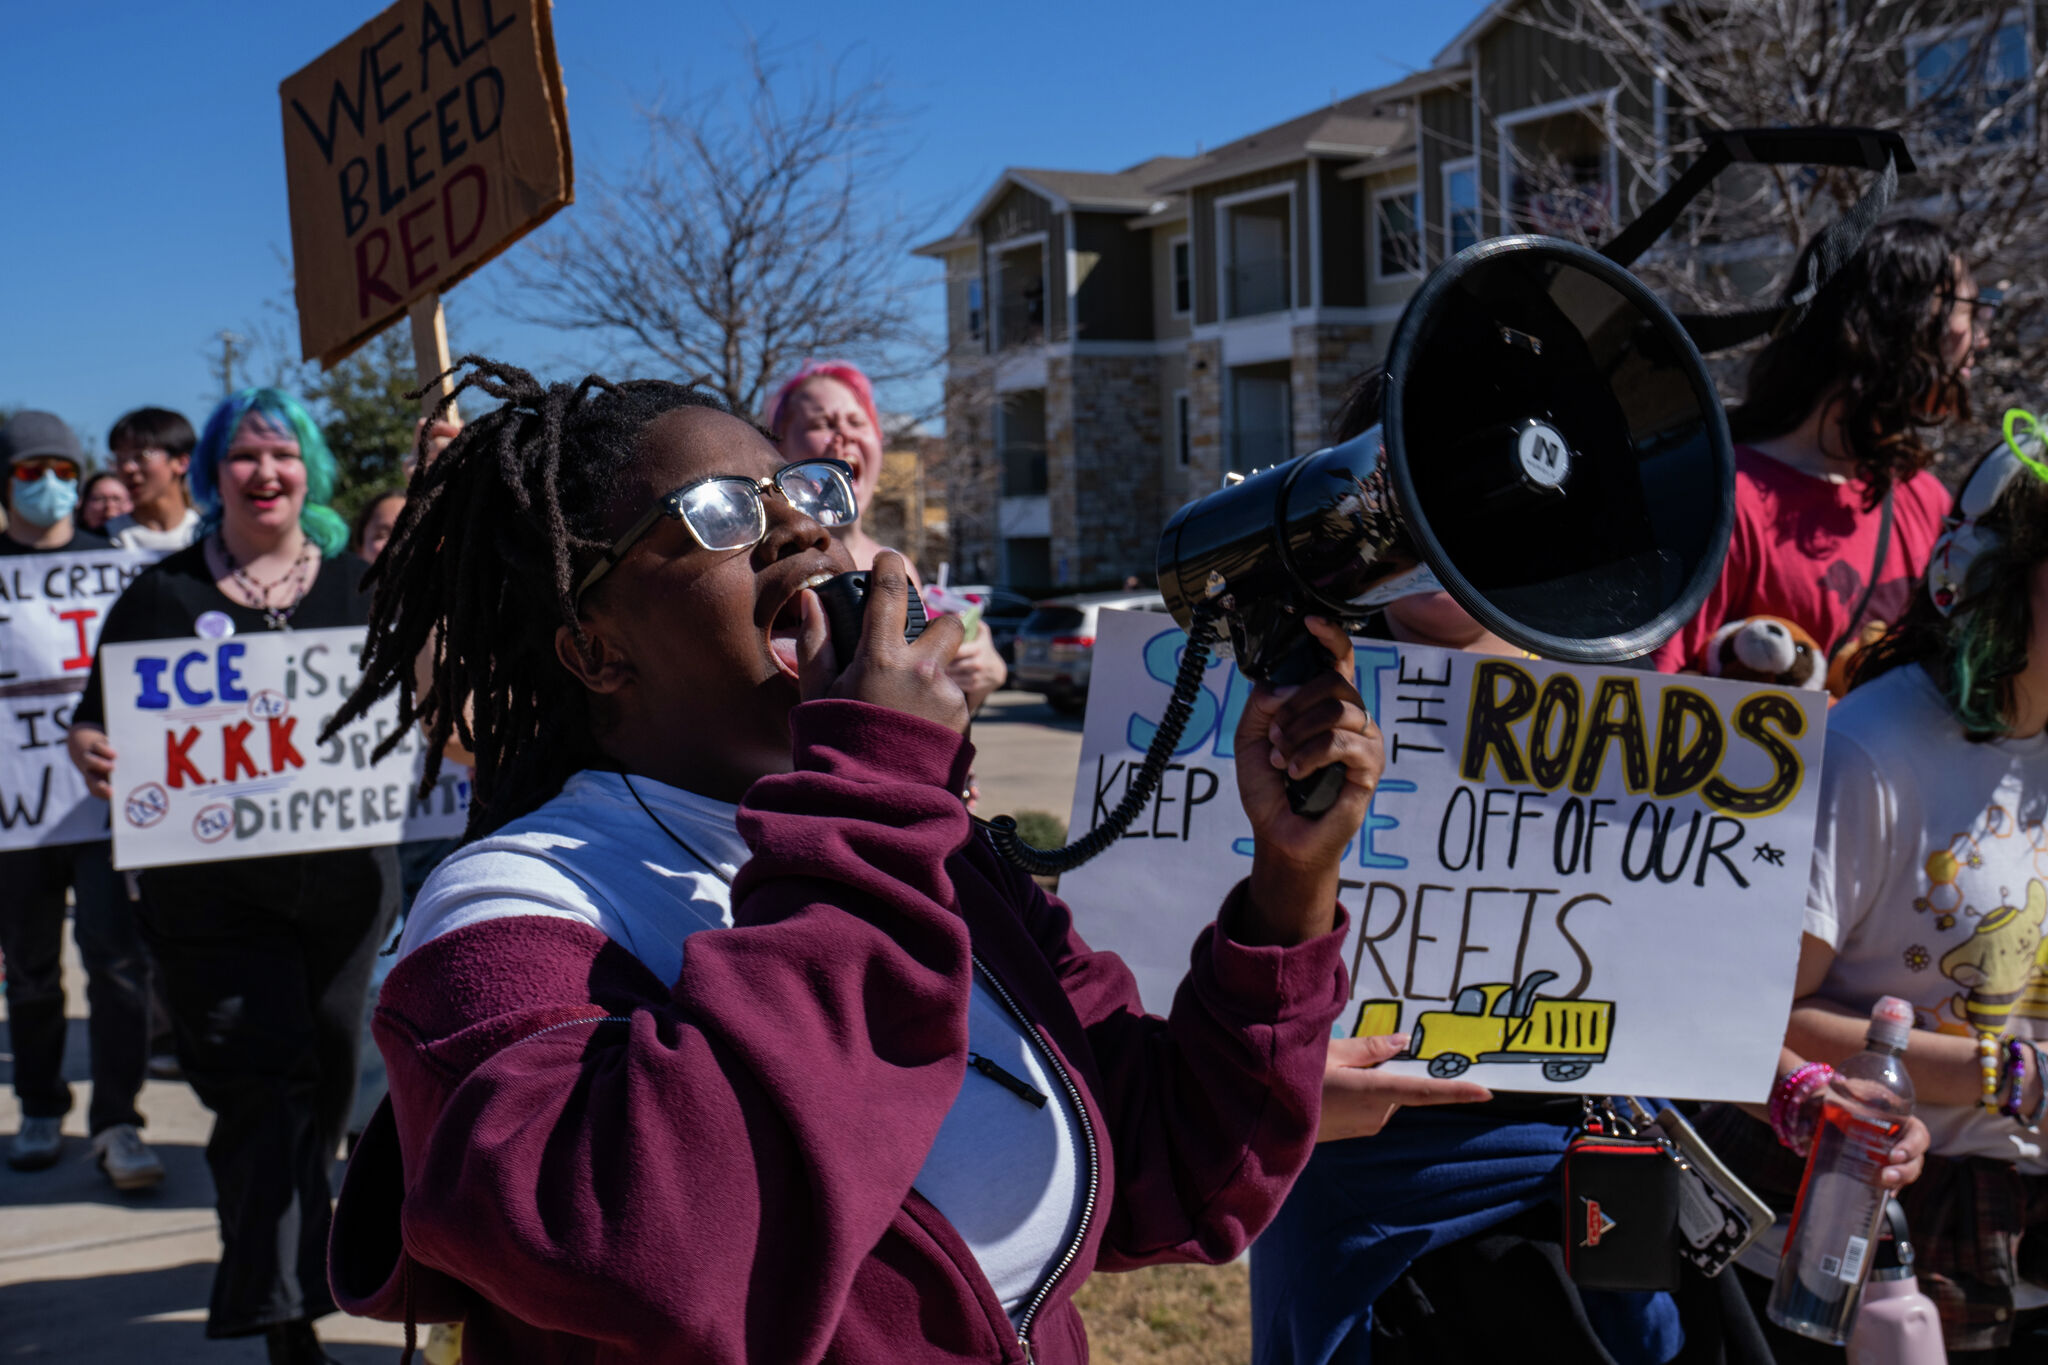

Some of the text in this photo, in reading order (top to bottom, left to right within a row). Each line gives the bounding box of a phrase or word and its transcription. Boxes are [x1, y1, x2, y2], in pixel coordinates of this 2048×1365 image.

[291, 0, 517, 165] WE ALL
[338, 65, 506, 239] BLEED
[354, 163, 489, 321] RED
[44, 563, 148, 599] CRIM
[134, 643, 249, 710] ICE
[1390, 654, 1452, 765] THE
[1460, 658, 1806, 819] ROADS
[1437, 785, 1548, 872] OFF
[1553, 796, 1617, 876] OF
[1620, 801, 1751, 889] OUR
[1337, 879, 1613, 1001] REETS
